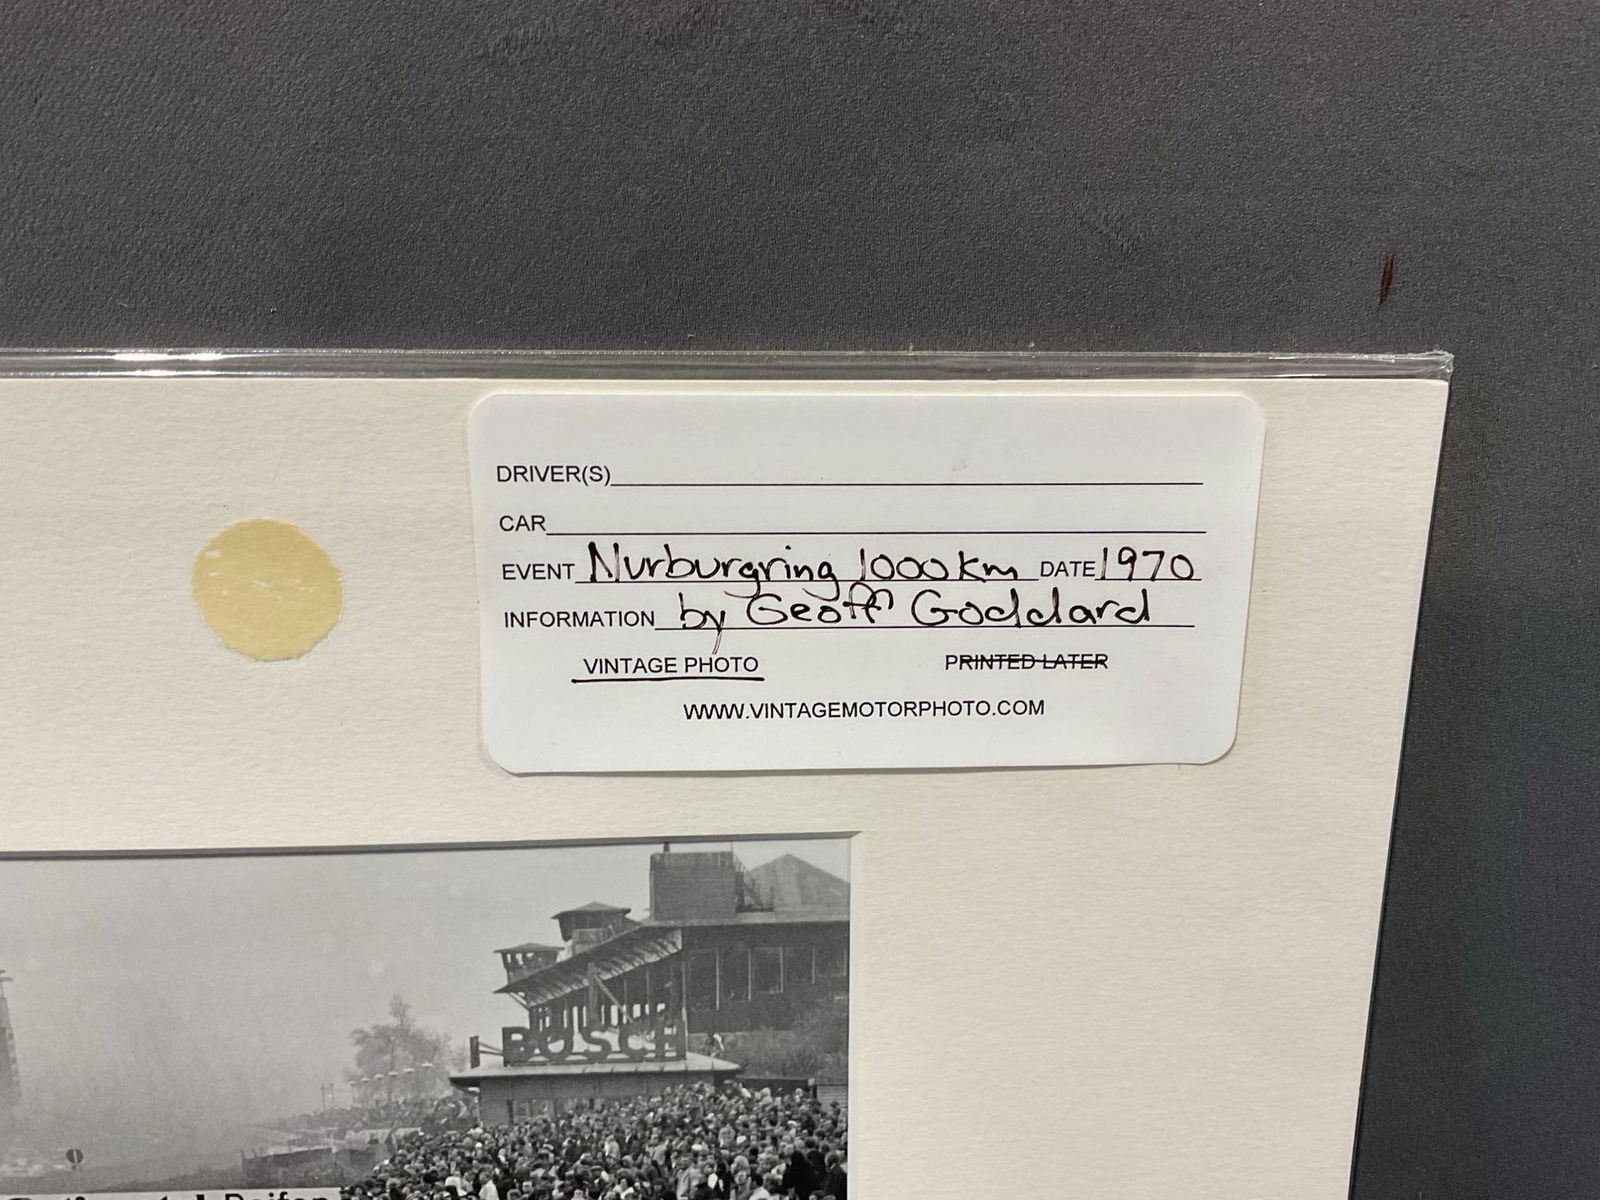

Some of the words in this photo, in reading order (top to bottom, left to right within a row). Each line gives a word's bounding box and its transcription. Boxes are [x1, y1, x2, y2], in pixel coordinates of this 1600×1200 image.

[496, 465, 612, 486] DRIVER(S)
[499, 514, 547, 532] CAR
[502, 563, 575, 580] EVENT
[588, 541, 841, 602] Nurburgring
[1040, 561, 1096, 578] DATE
[1100, 546, 1195, 582] 1970
[504, 610, 656, 628] INFORMATION
[678, 591, 726, 655] by
[746, 580, 895, 625] Geoff
[911, 586, 1150, 628] Goddard
[583, 657, 678, 674] VINTAGE
[684, 656, 760, 674] PHOTO
[945, 654, 1036, 670] PRINTED
[1043, 653, 1109, 670] LATER
[683, 700, 1046, 720] WWW.VINTAGEMOTORPHOTO.COM
